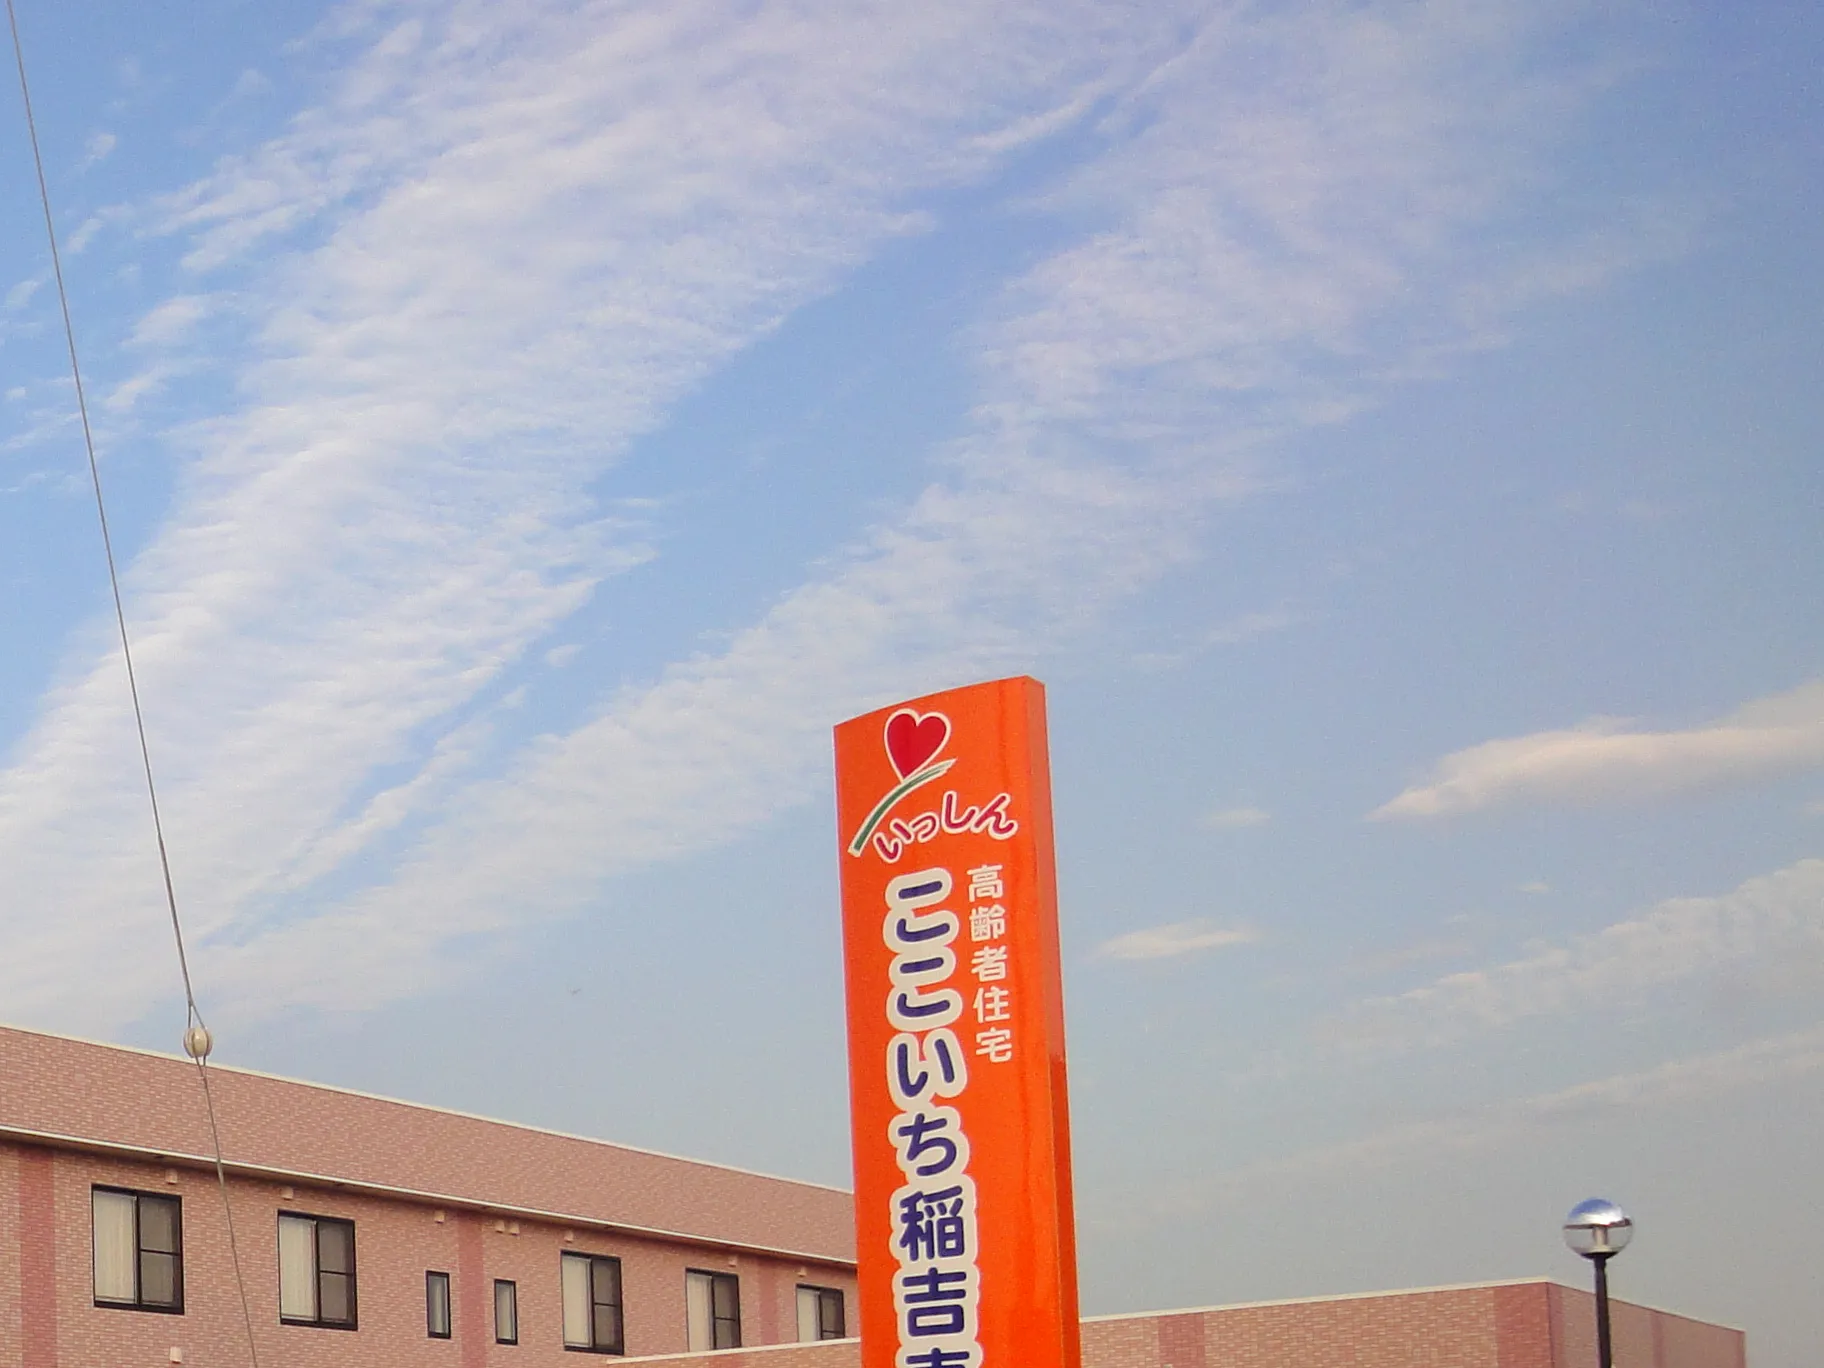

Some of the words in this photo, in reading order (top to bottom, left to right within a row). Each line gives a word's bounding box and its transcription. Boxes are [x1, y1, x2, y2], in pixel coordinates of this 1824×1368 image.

[873, 791, 1018, 863] いっしん
[966, 864, 1013, 1064] 高齢者住宅
